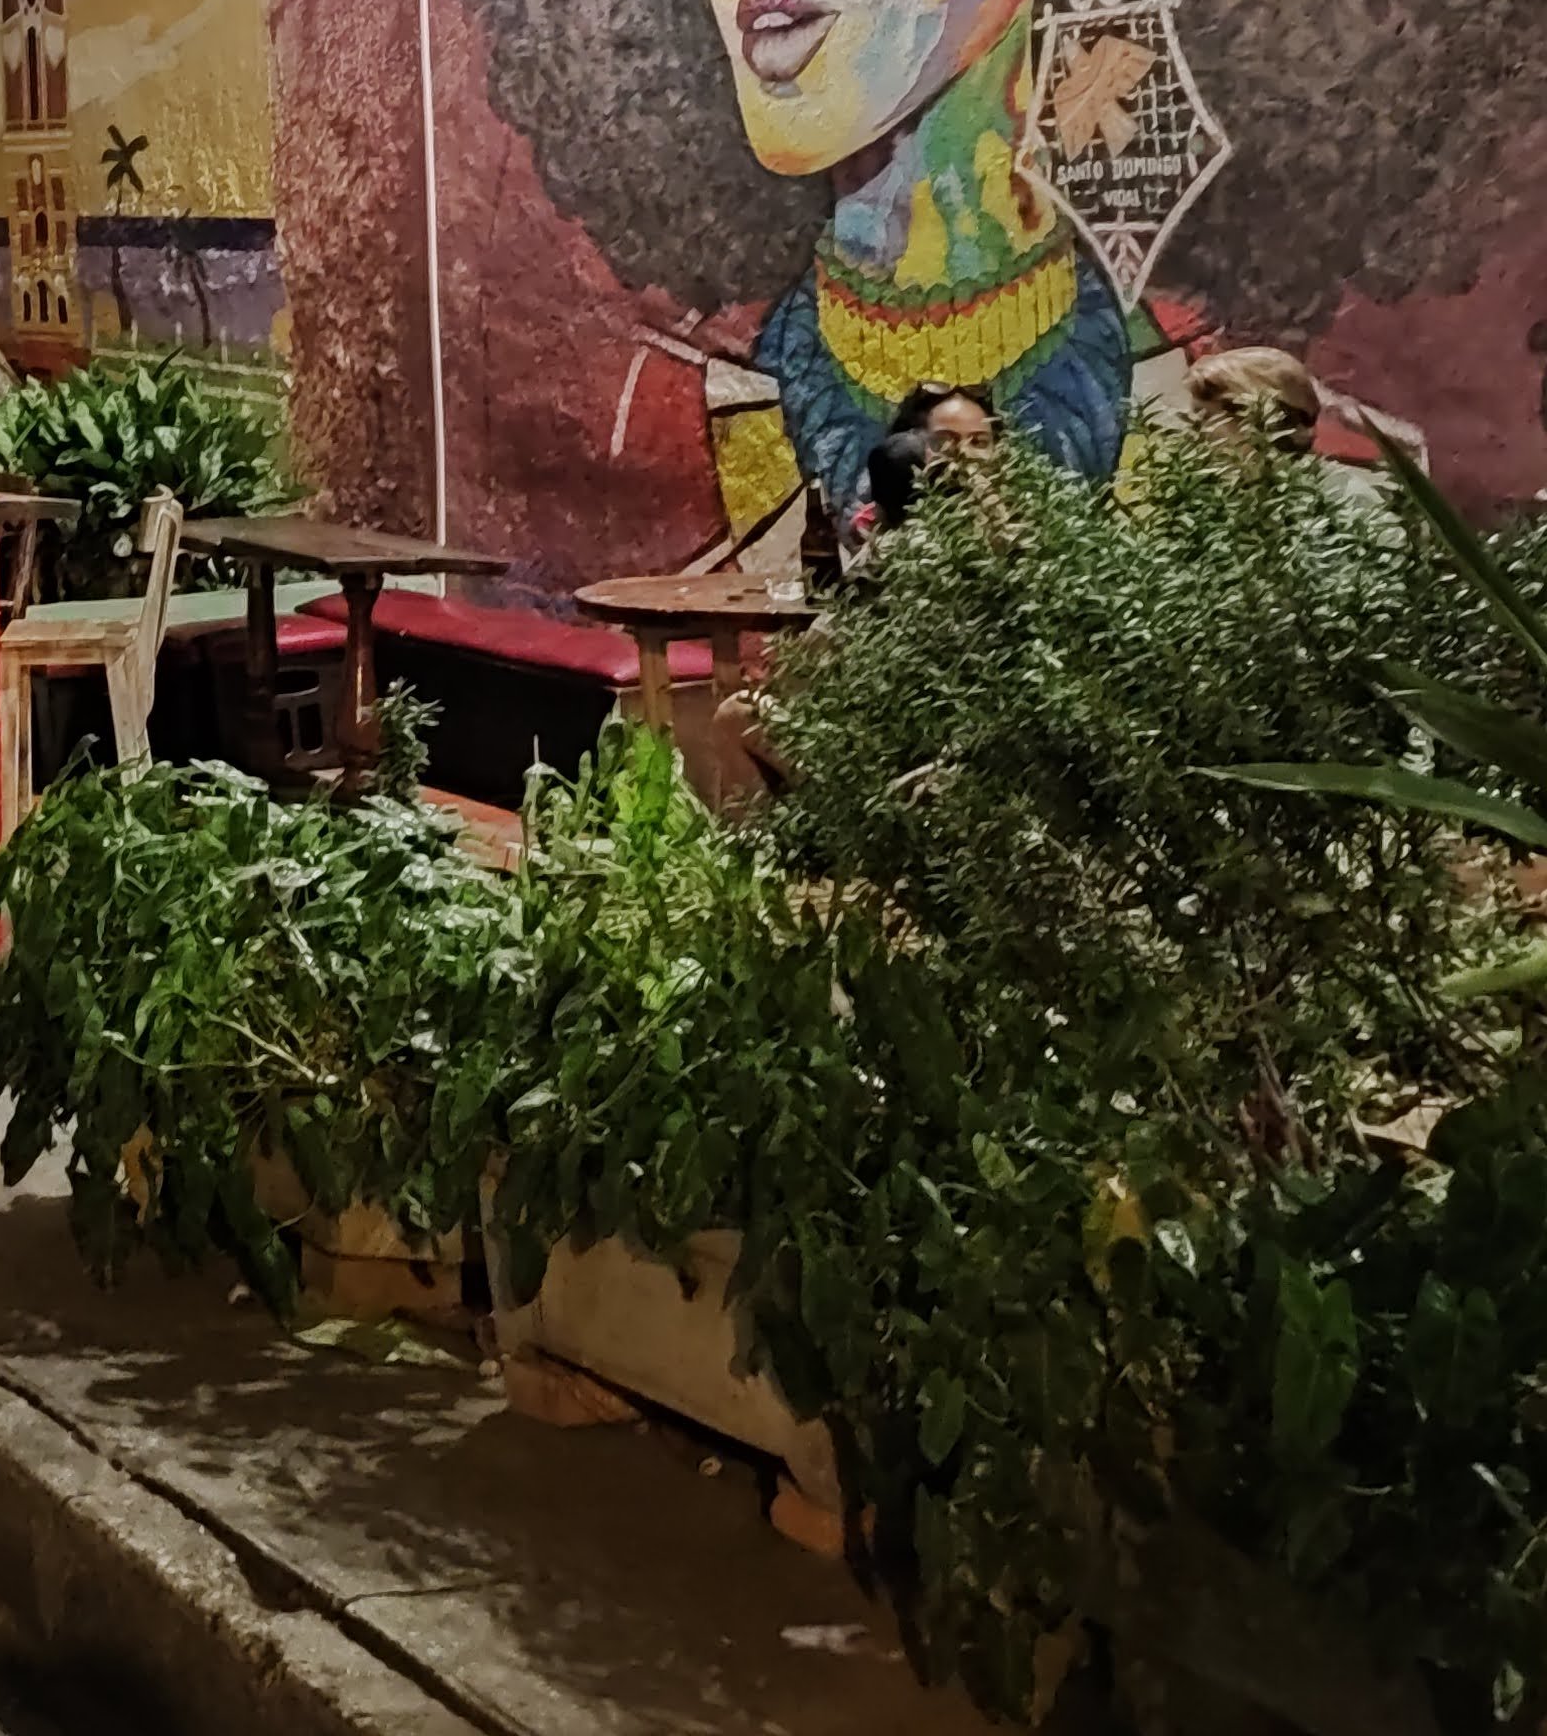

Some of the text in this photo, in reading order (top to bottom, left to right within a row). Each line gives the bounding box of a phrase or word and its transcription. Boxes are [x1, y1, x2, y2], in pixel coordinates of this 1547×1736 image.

[1057, 154, 1182, 185] SANTO DOMINGO
[1101, 187, 1142, 208] VIDAL
